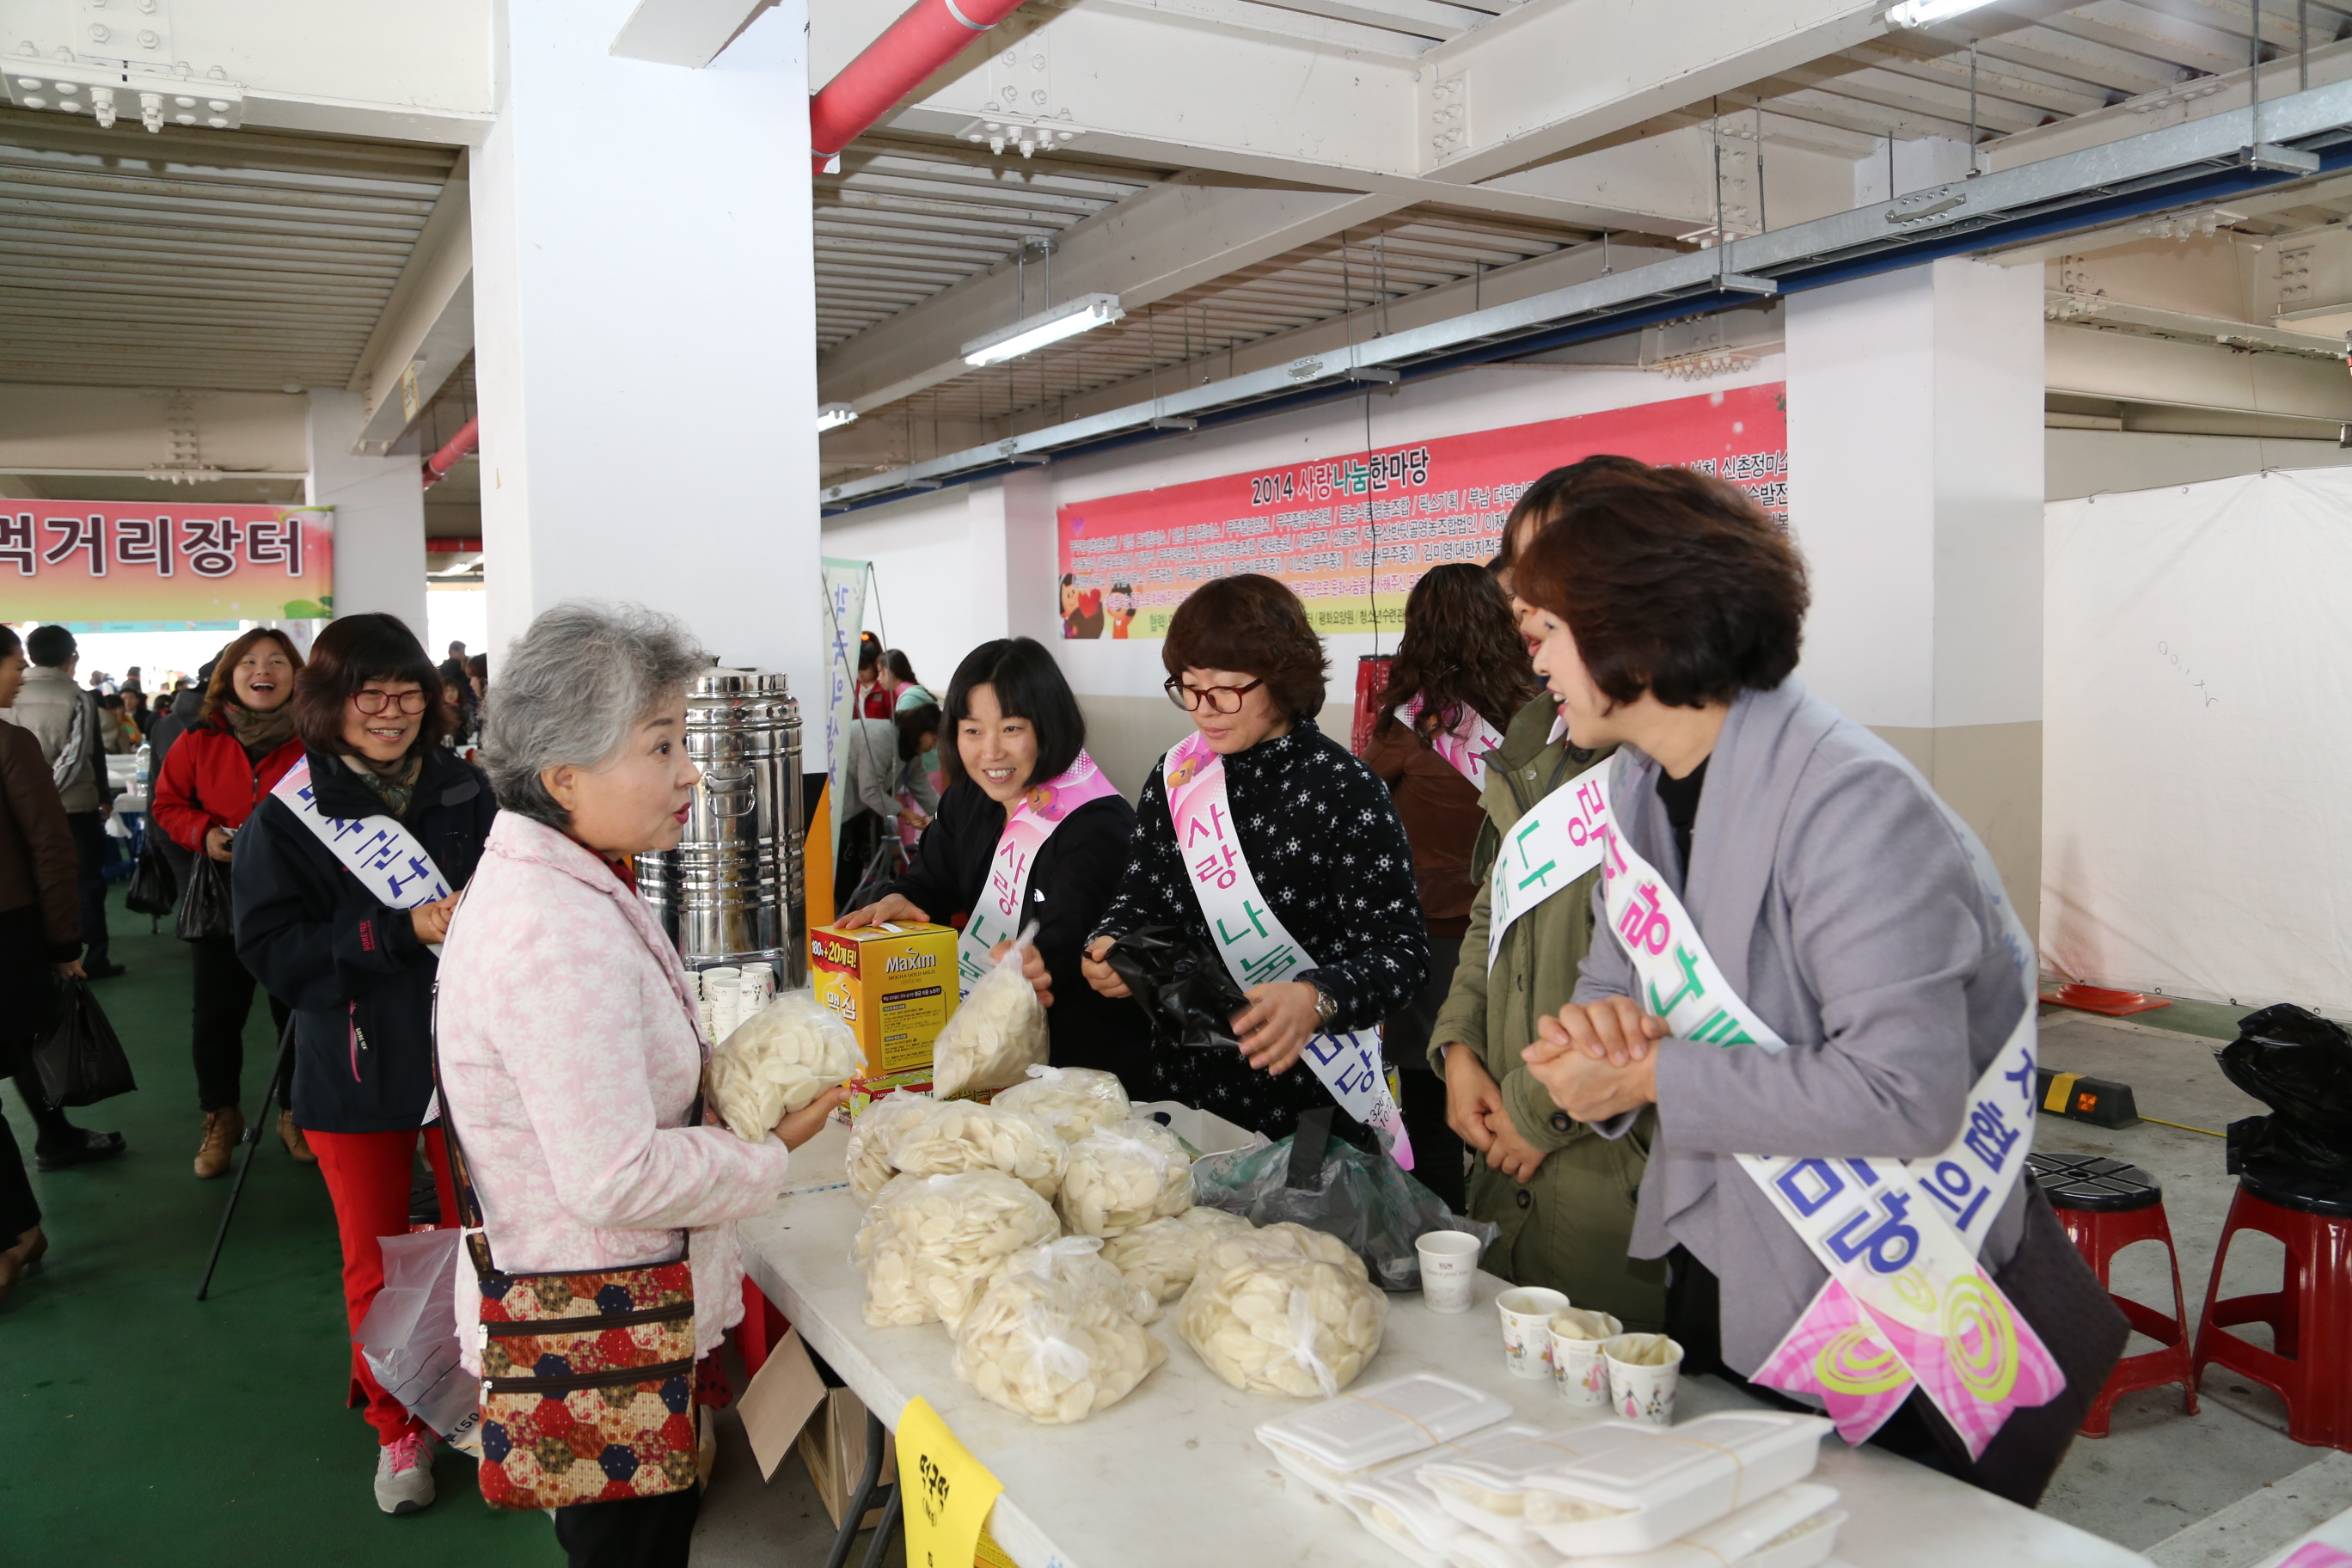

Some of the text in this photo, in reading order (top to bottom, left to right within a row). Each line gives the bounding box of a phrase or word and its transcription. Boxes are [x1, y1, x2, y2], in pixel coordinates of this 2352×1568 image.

[1252, 472, 1293, 505] 2014
[1419, 491, 1459, 513] 픽스기획
[1468, 487, 1490, 508] 부남
[885, 948, 936, 973] Maxim
[827, 989, 857, 1021] 맥심
[920, 1454, 950, 1513] 떡국떡
